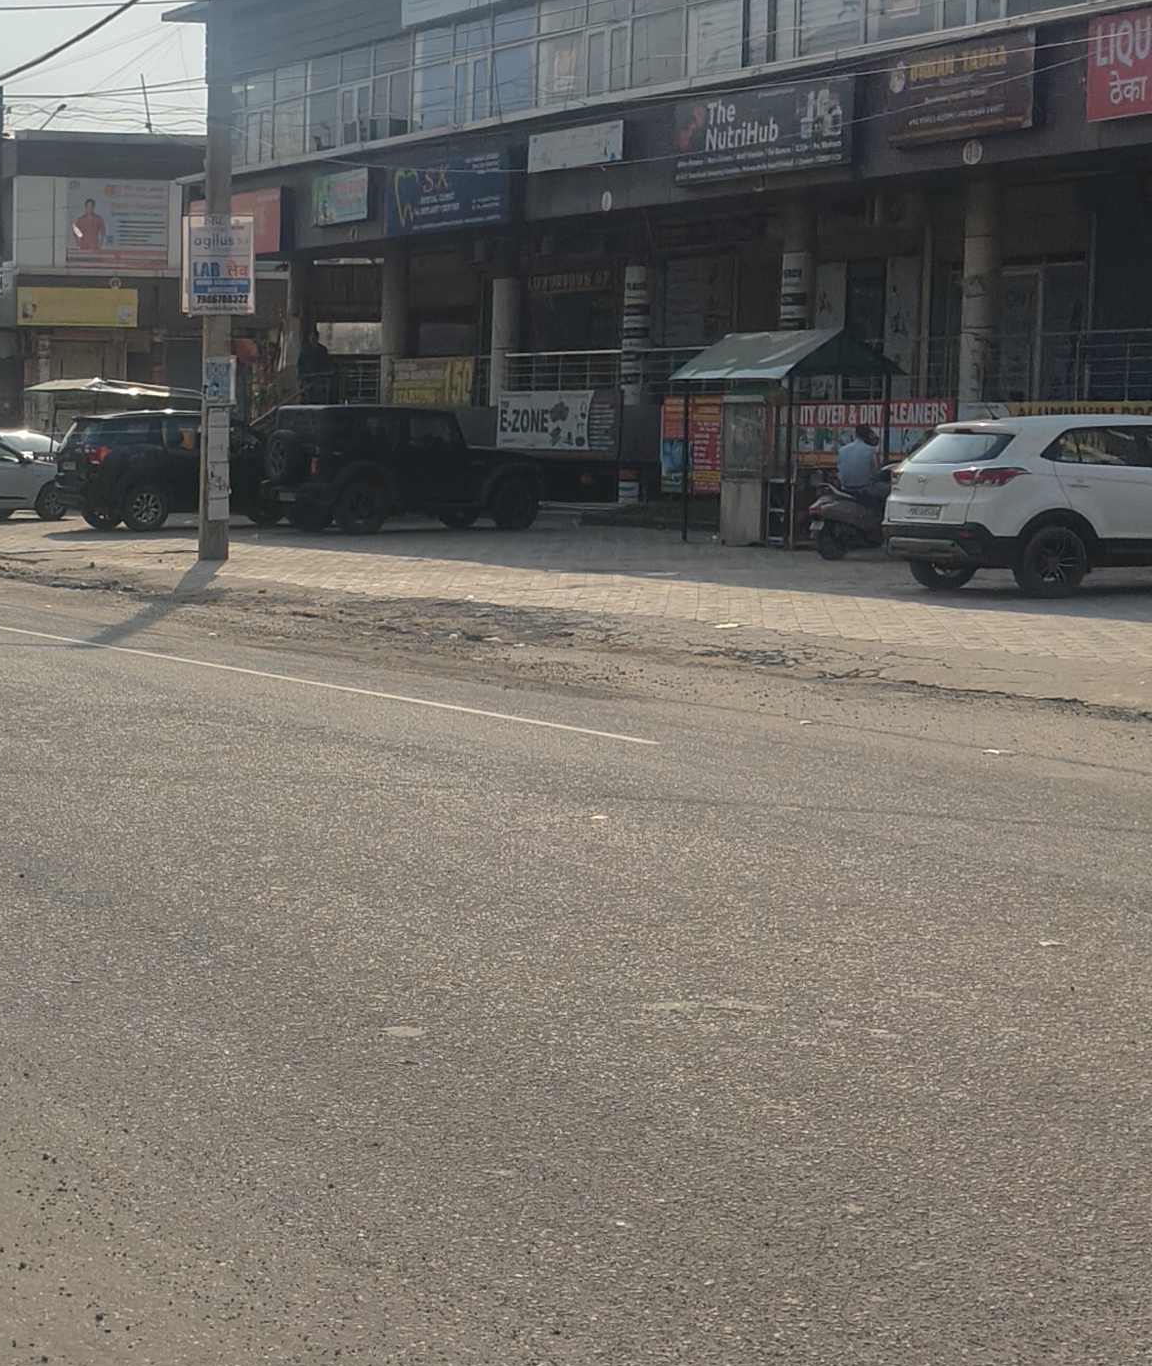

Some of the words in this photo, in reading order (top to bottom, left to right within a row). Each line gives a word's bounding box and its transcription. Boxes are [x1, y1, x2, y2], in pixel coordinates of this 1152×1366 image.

[1095, 16, 1152, 68] LIQU
[1109, 70, 1147, 105] ठेका
[707, 99, 736, 125] The
[705, 116, 779, 151] NutriHub
[193, 232, 235, 250] agilus
[193, 261, 221, 277] LAB
[499, 409, 549, 433] E-ZONE
[817, 404, 846, 425] DYER
[848, 404, 858, 424] &
[859, 404, 883, 425] DRY
